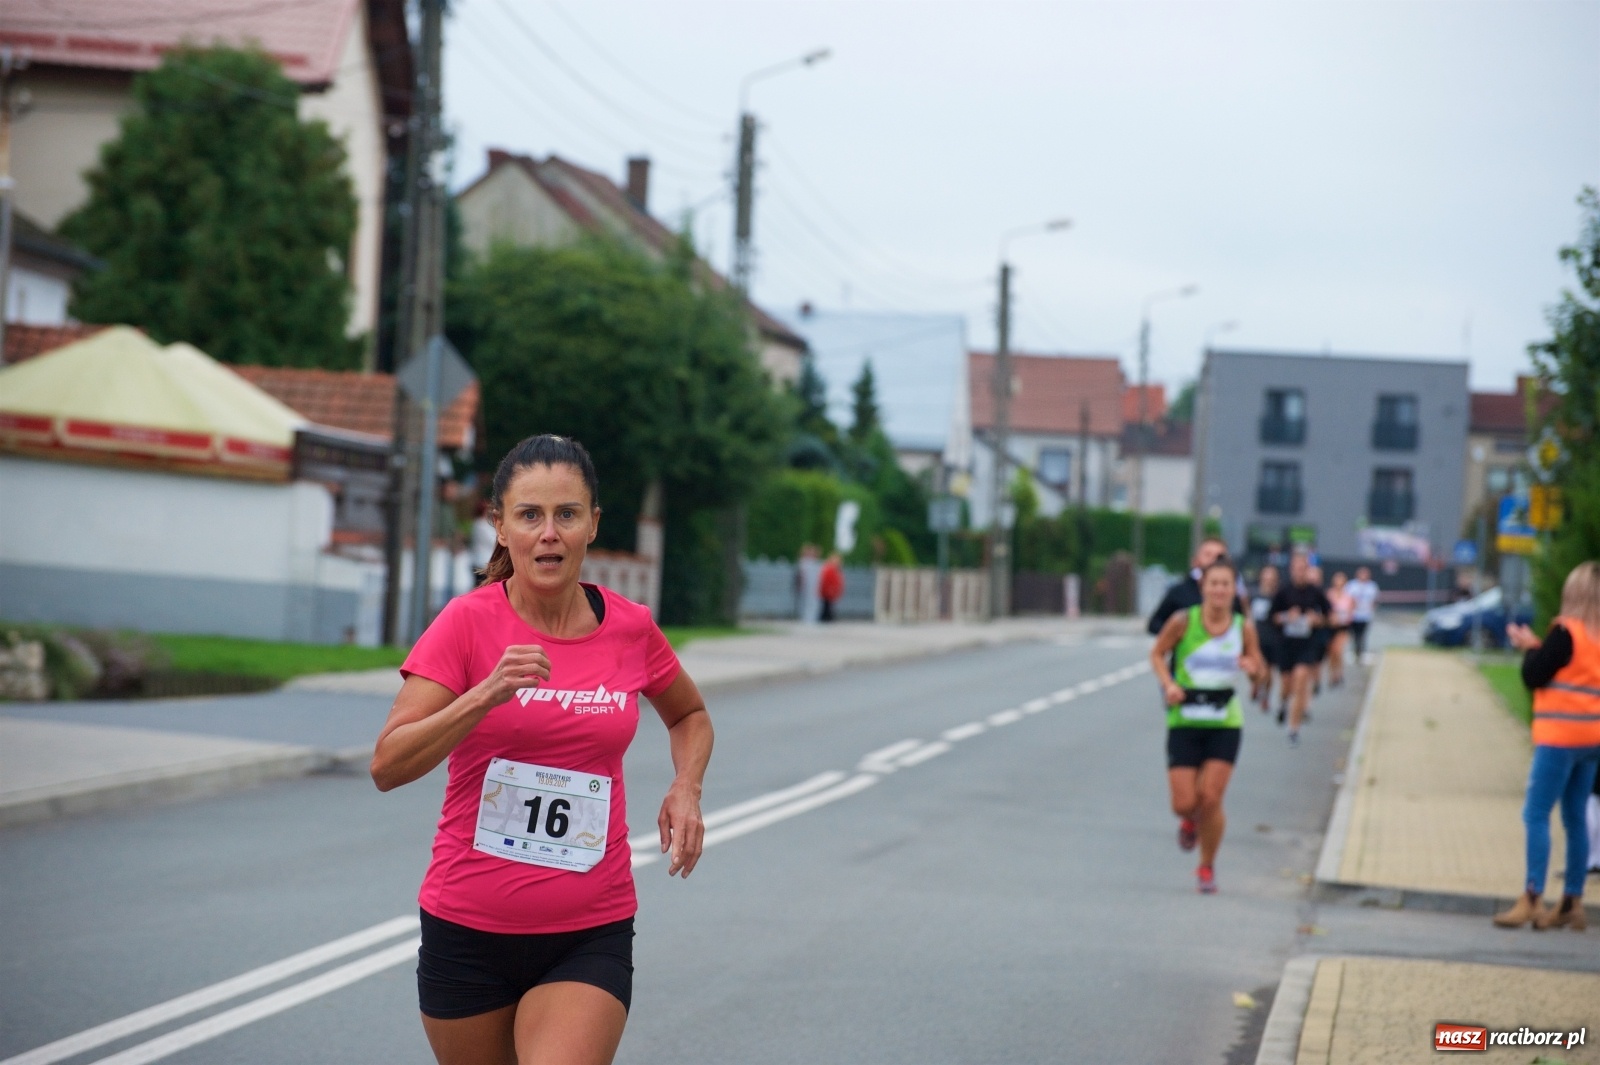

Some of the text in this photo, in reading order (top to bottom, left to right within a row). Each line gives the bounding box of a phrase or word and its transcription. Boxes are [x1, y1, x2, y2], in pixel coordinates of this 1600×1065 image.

[574, 706, 615, 714] SPORT
[538, 777, 568, 788] 19.09.2021
[524, 796, 571, 838] 16
